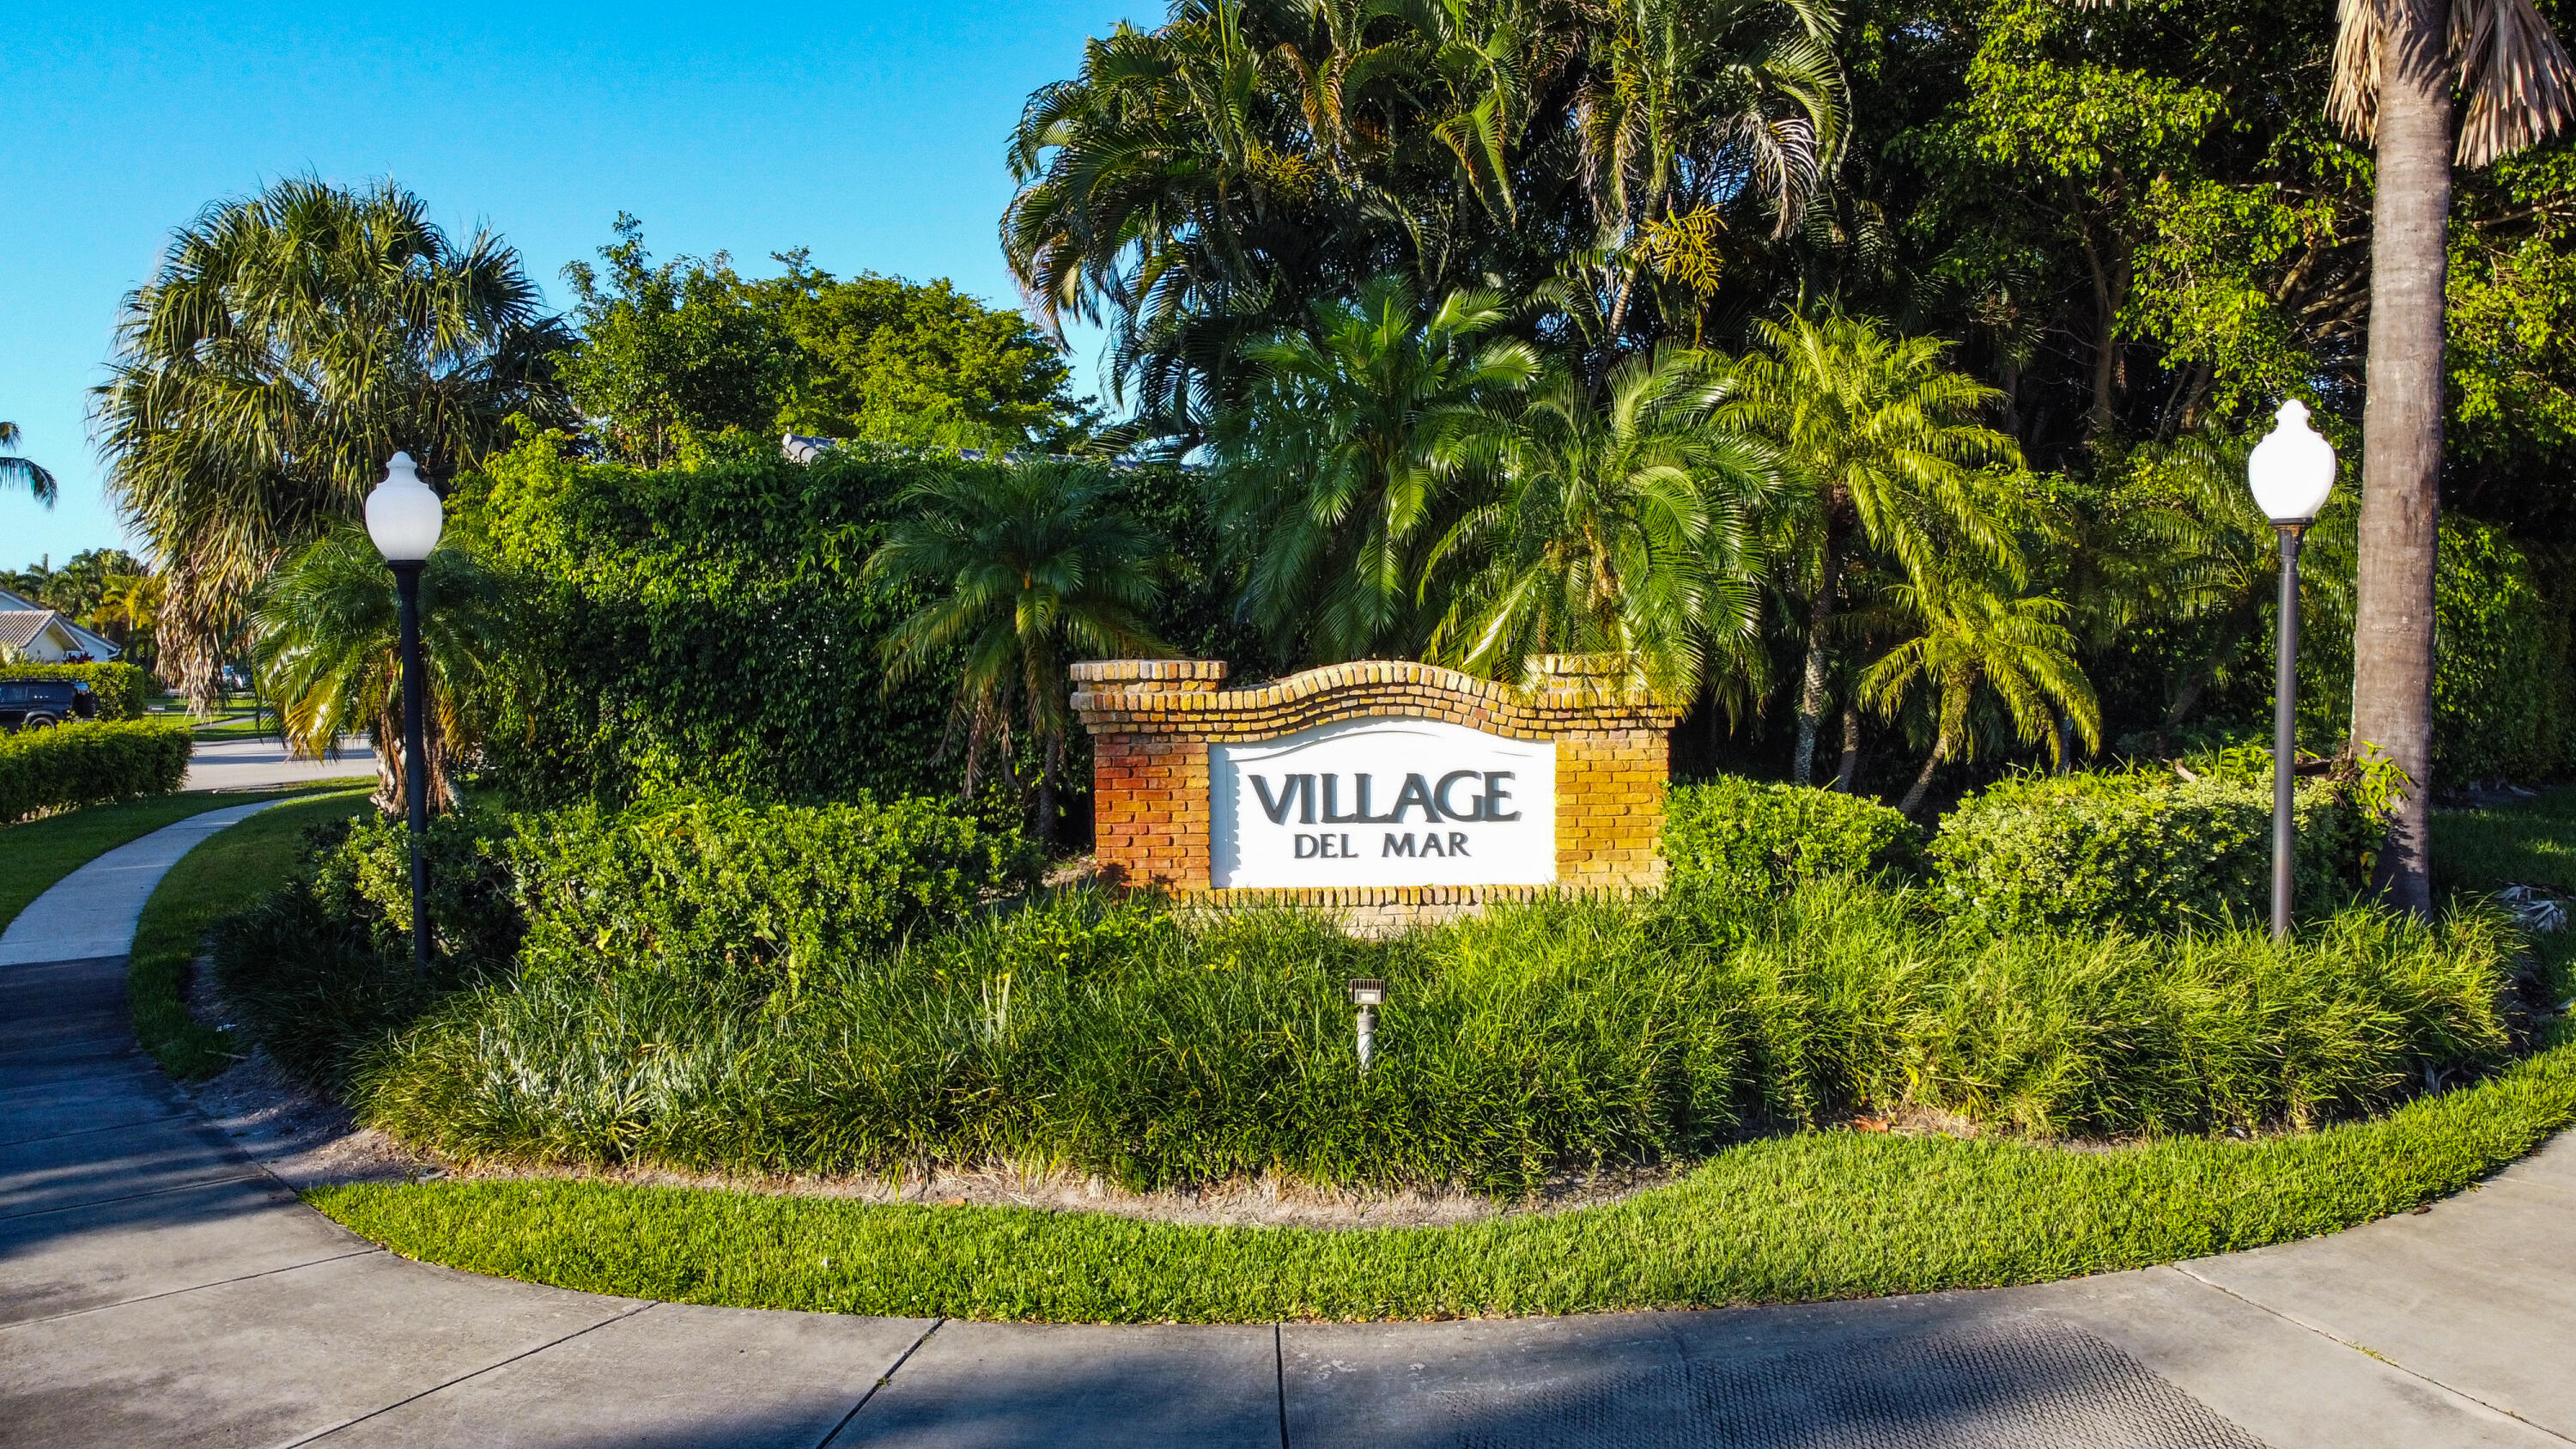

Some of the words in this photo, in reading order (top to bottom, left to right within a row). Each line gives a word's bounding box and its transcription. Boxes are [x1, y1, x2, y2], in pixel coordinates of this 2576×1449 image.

[1248, 770, 1522, 825] VILLAGE
[1294, 833, 1358, 859] DEL
[1382, 831, 1472, 858] MAR
